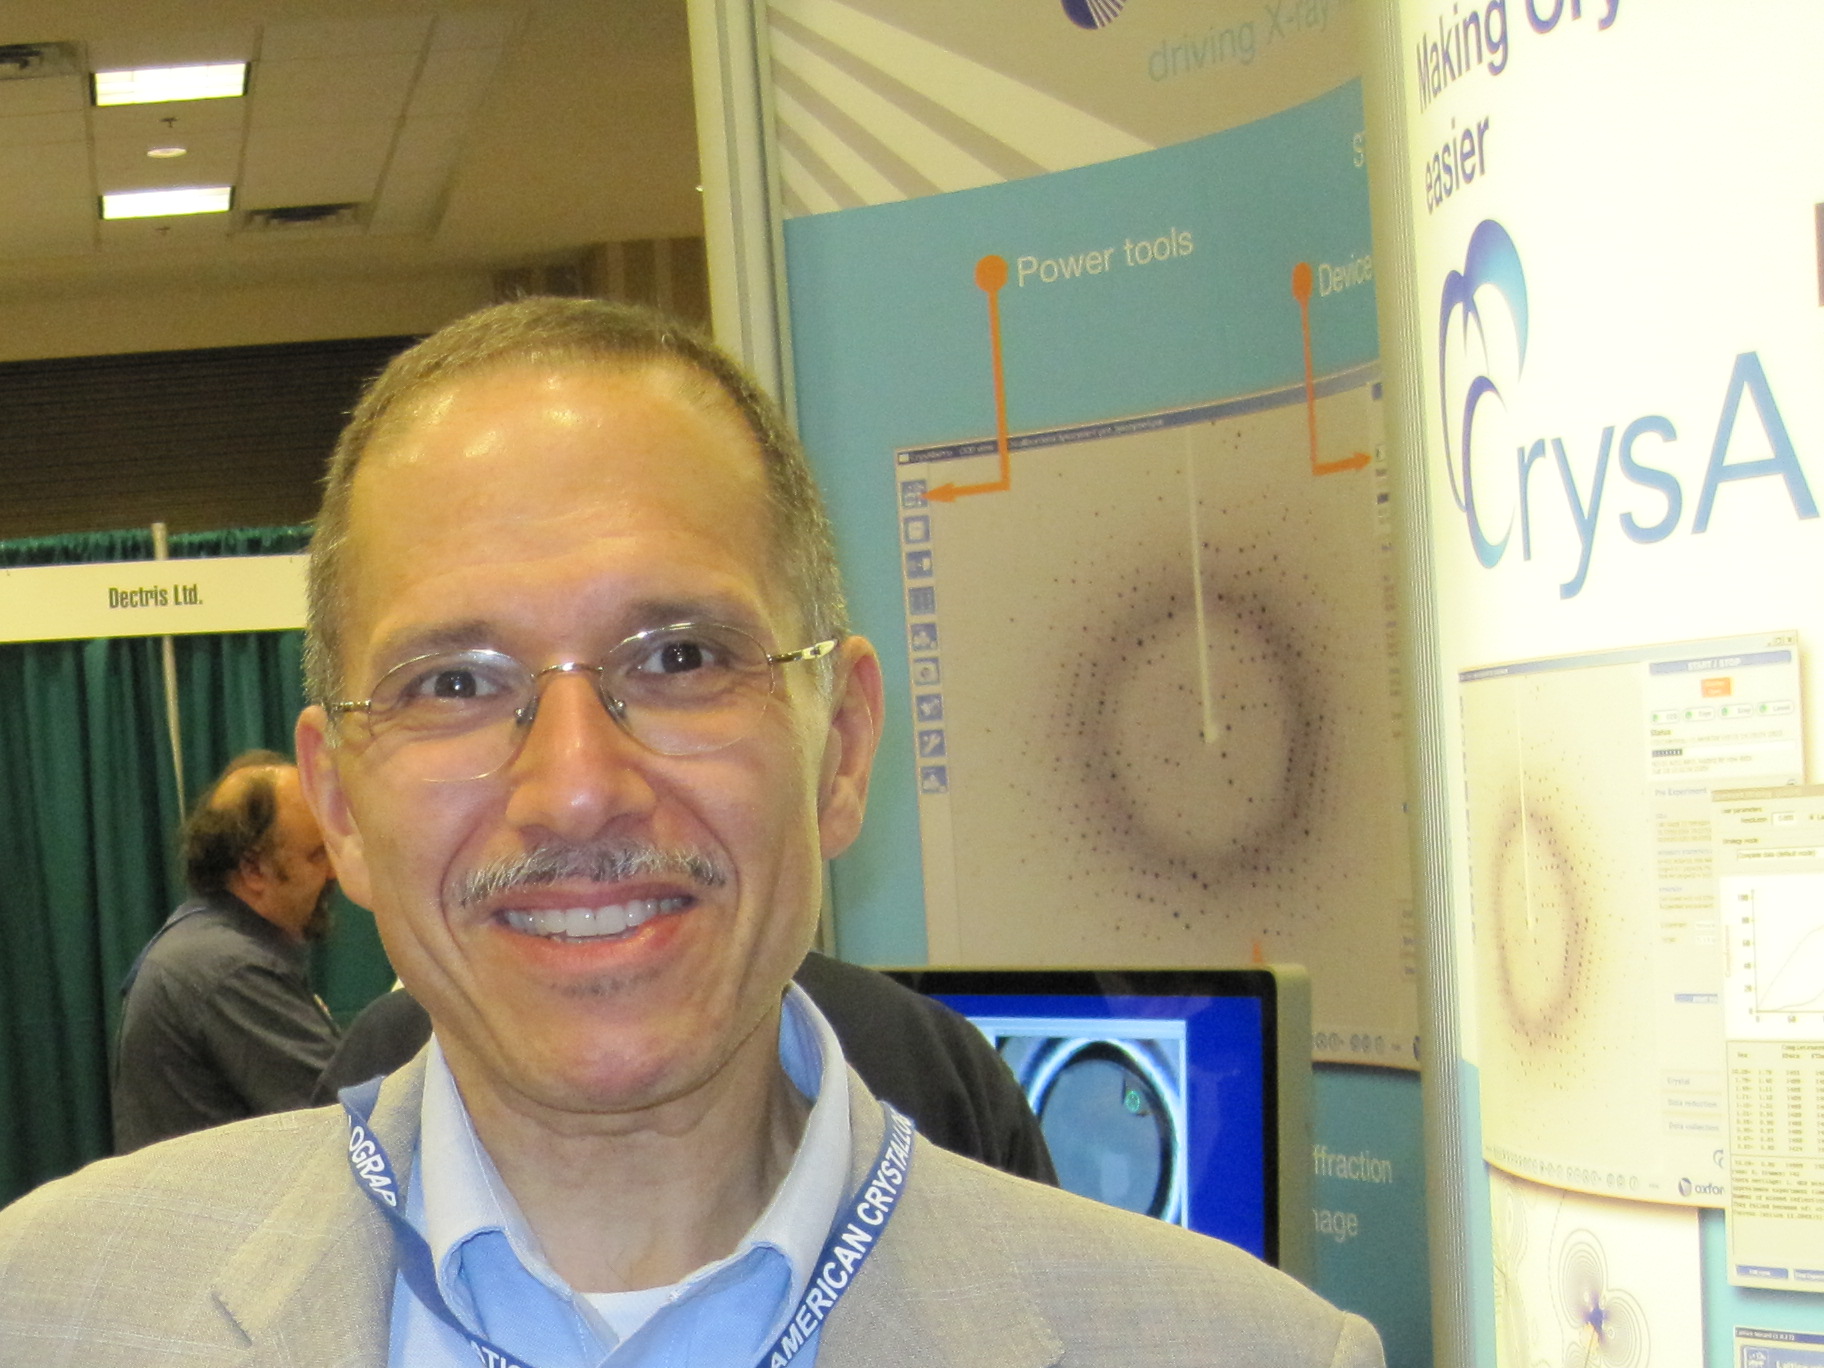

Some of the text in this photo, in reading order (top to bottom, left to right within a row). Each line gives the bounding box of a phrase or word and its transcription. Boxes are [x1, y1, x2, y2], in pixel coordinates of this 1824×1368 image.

[1147, 20, 1255, 82] driving
[1425, 115, 1490, 215] easier
[1016, 227, 1194, 288] Power tools
[108, 584, 203, 608] Dectris Ltd.
